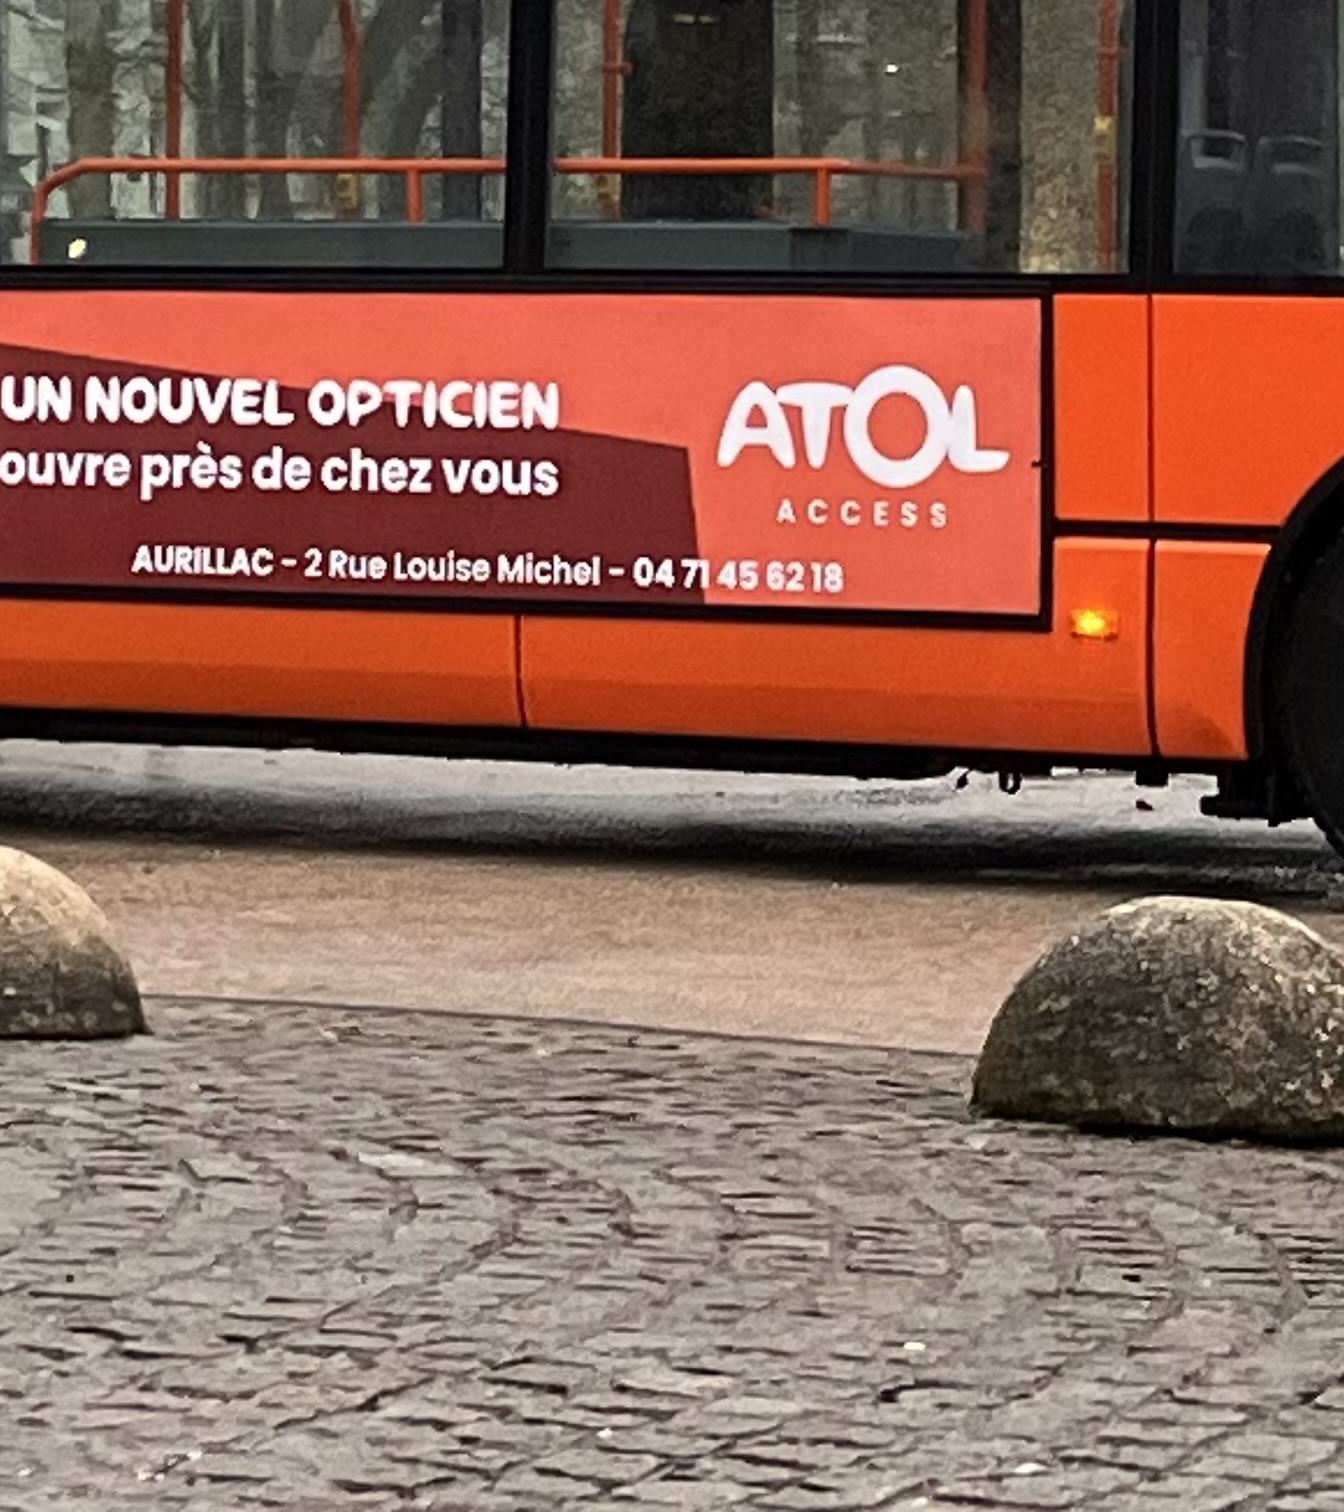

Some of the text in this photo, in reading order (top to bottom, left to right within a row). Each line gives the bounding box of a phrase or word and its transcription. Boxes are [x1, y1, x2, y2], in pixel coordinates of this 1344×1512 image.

[1, 375, 559, 429] UN NOUVEL OPTICIEN
[716, 365, 1010, 488] ATOL
[140, 441, 242, 501] près
[252, 445, 311, 490] de
[321, 447, 432, 493] chez
[441, 458, 559, 496] vous
[777, 498, 949, 528] ACCESS
[131, 545, 274, 577] AURILLAC
[304, 548, 322, 577] 2
[328, 550, 387, 580] Rue
[393, 550, 490, 582] Louise
[497, 552, 601, 586] Michel
[633, 557, 675, 588] 04
[681, 559, 710, 589] 71
[717, 560, 759, 590] 45
[766, 561, 805, 591] 62
[811, 562, 844, 593] 18
